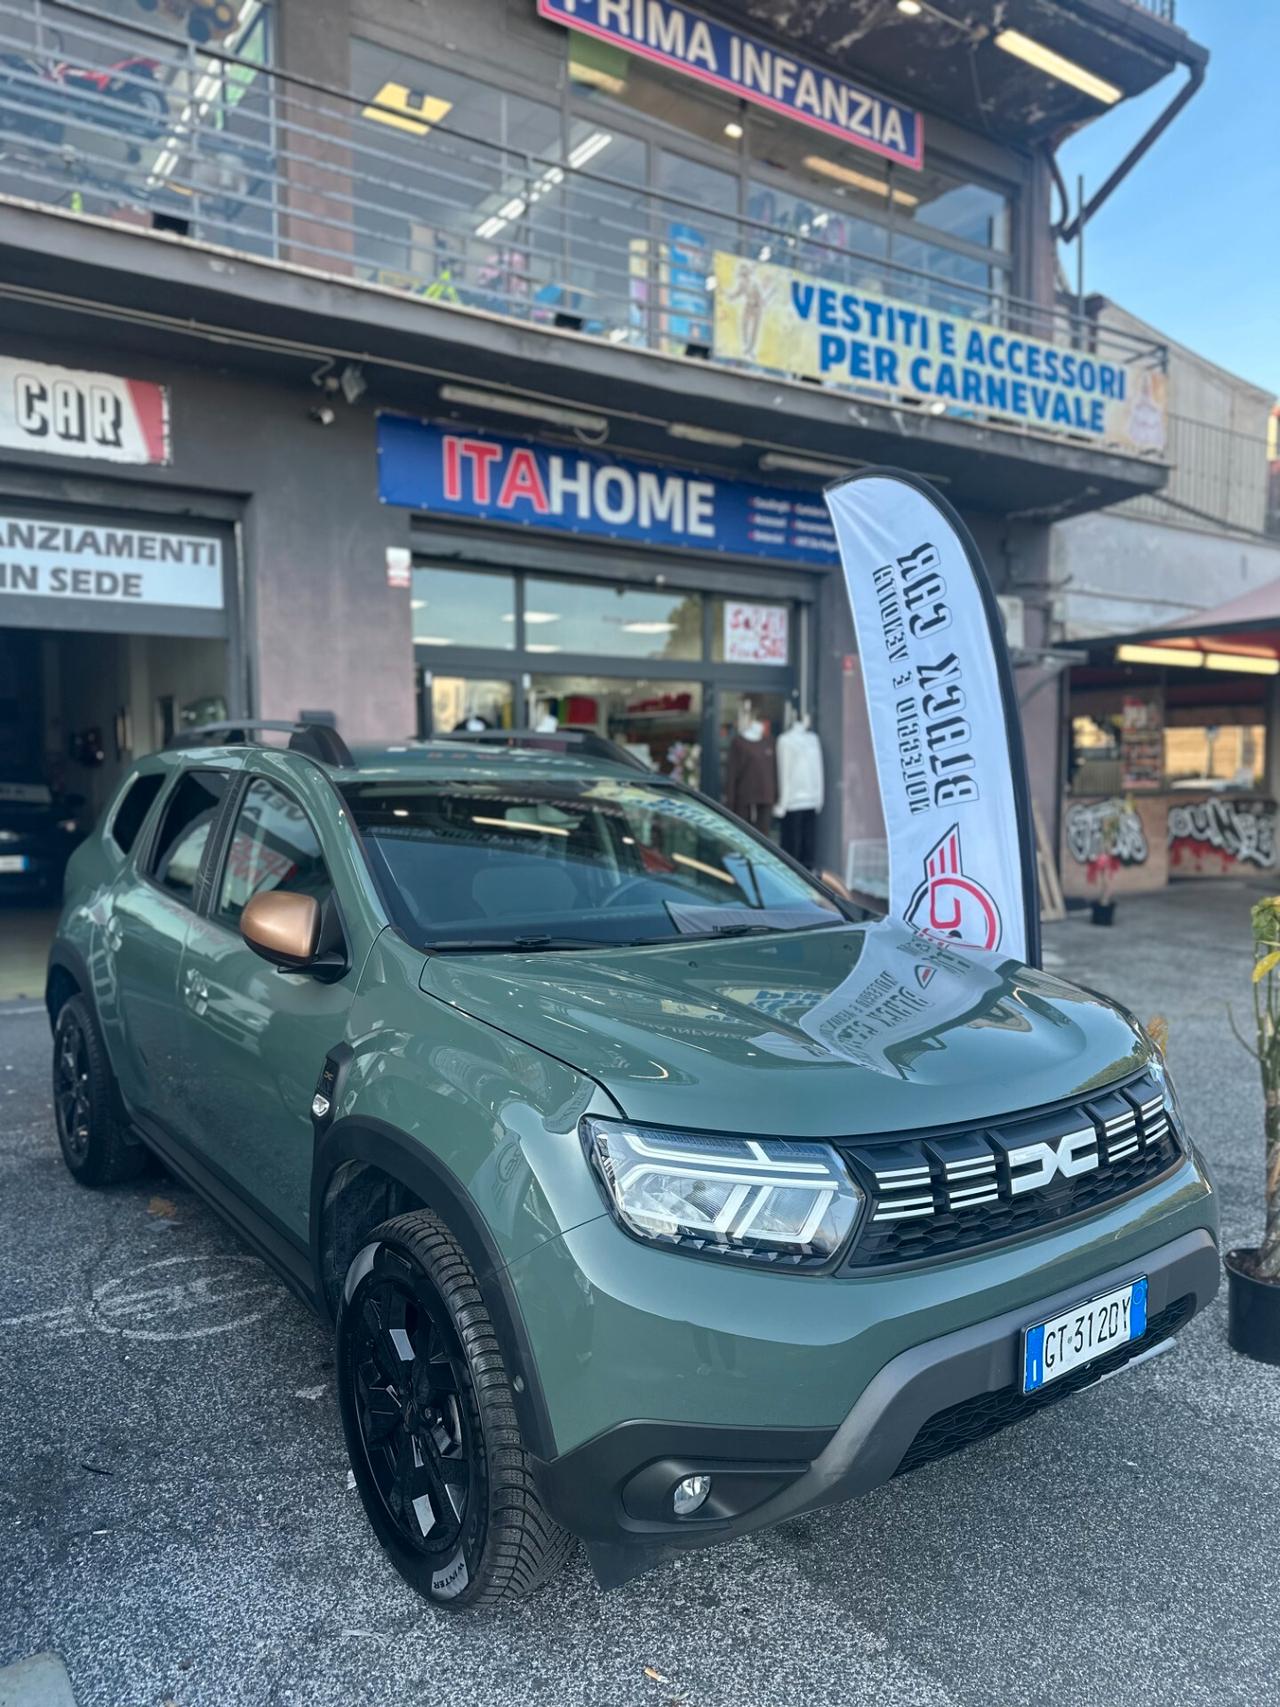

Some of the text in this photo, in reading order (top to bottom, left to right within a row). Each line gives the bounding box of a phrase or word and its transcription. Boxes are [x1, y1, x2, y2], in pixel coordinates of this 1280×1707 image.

[730, 36, 907, 151] INFANZIA
[791, 281, 1127, 400] VESTITI E ACCESSORI
[820, 333, 1106, 433] PER CARNEVALE
[14, 373, 123, 448] CAR
[442, 435, 716, 538] ITAHOME
[0, 522, 217, 566] NZIAMENTI
[49, 566, 143, 598] SEDE
[433, 1562, 465, 1590] WINTER
